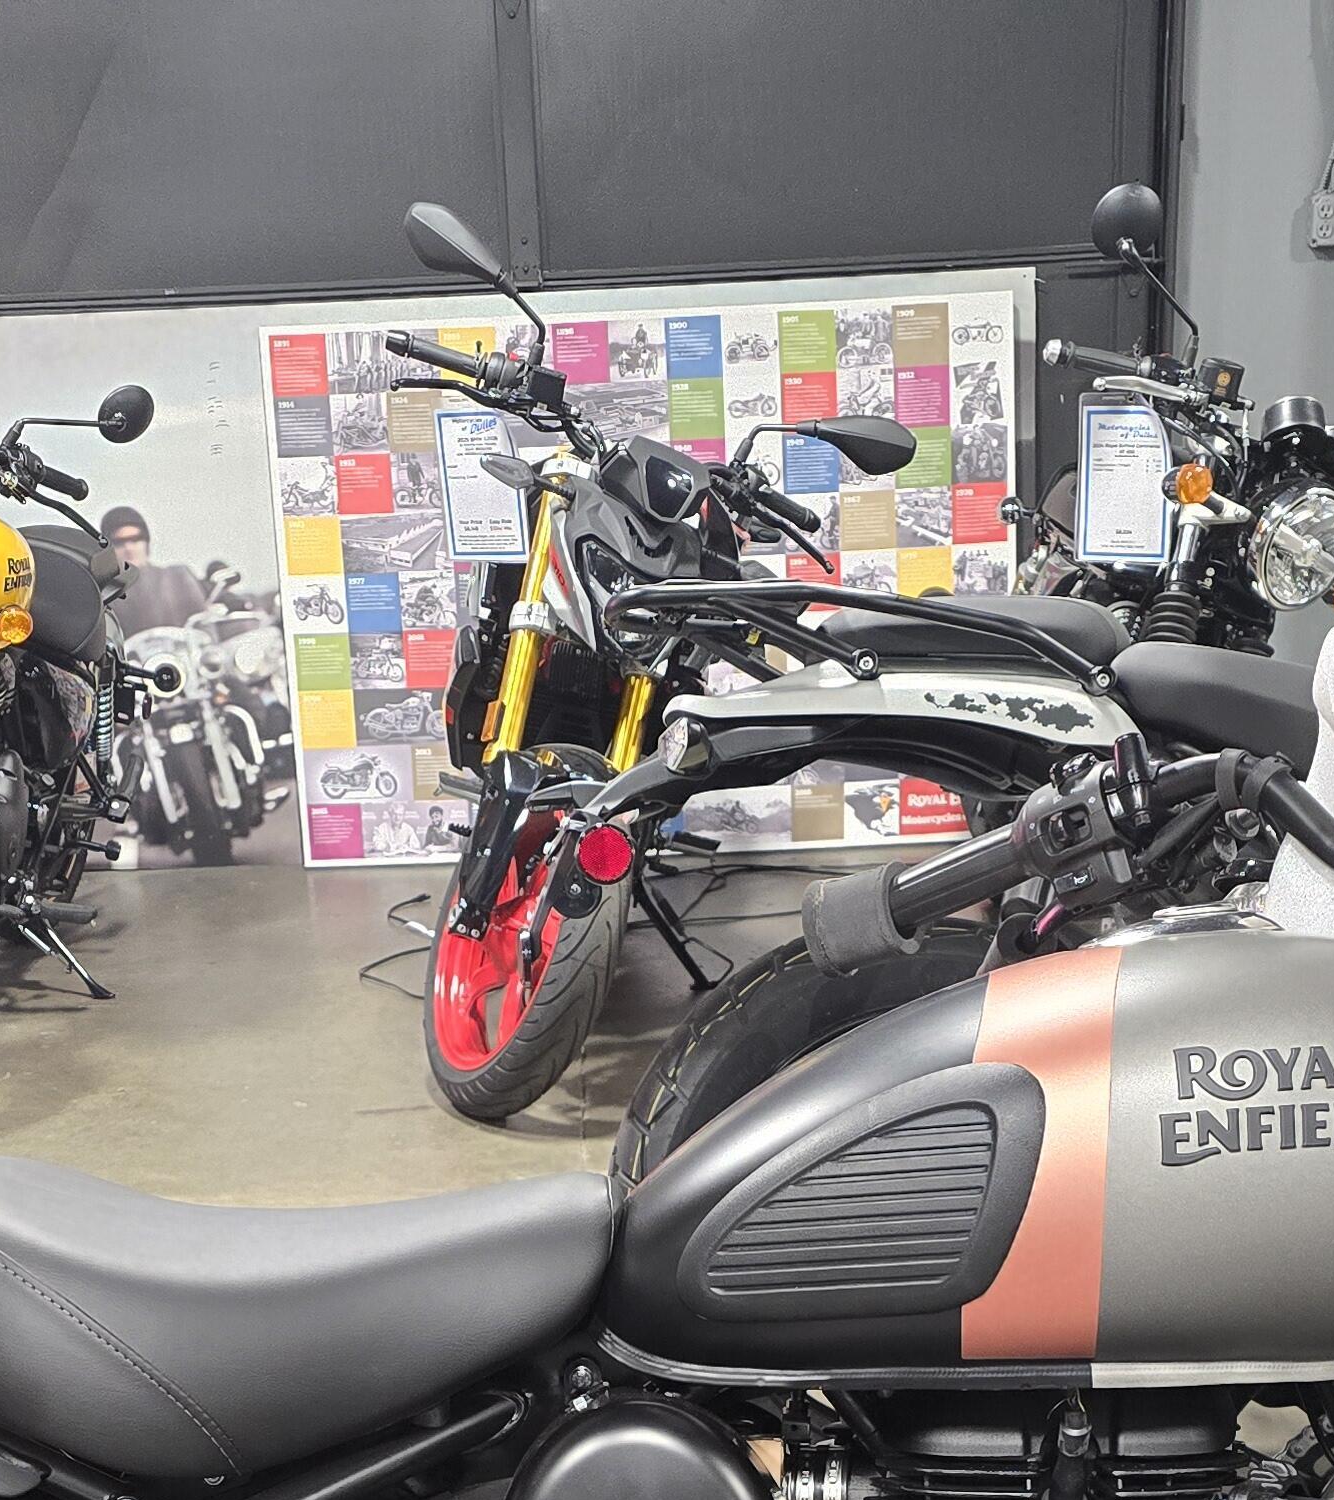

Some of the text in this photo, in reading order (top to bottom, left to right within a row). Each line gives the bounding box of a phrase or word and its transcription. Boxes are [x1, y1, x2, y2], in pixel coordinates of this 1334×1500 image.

[669, 322, 687, 330] 1900
[348, 577, 365, 585] 1977
[907, 793, 948, 808] ROYAL
[901, 812, 961, 826] Motorcycles
